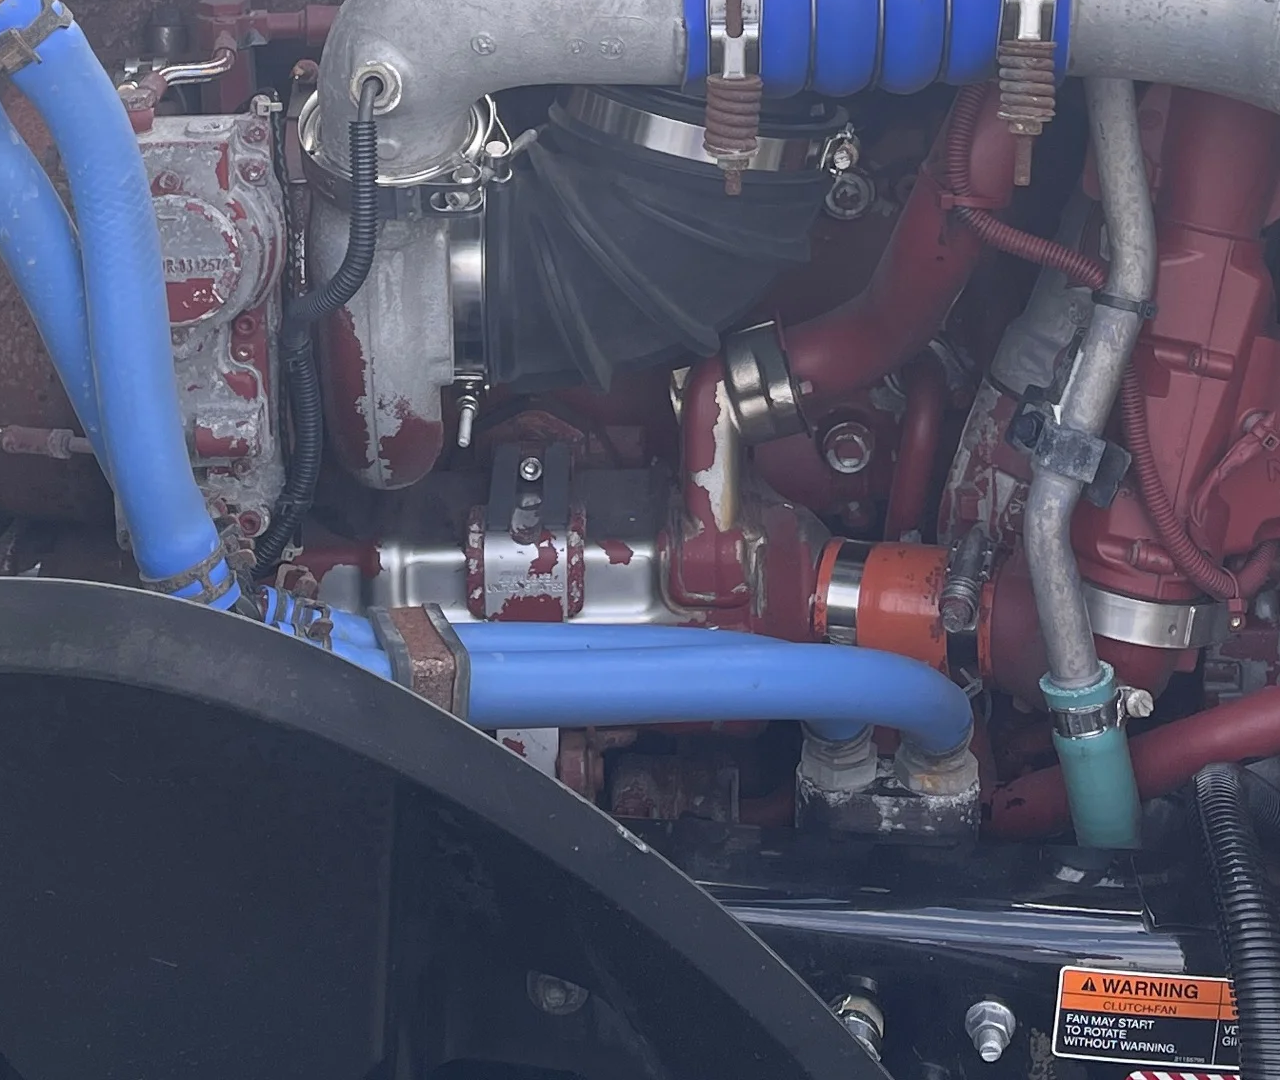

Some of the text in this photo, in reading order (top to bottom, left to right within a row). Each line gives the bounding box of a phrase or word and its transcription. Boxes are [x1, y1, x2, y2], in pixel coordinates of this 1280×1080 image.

[1103, 978, 1198, 999] WARNING
[1066, 1013, 1155, 1031] FAN MAY START
[1065, 1025, 1127, 1040] TO ROTATE
[1063, 1036, 1178, 1055] WITHOUT WARNING.
